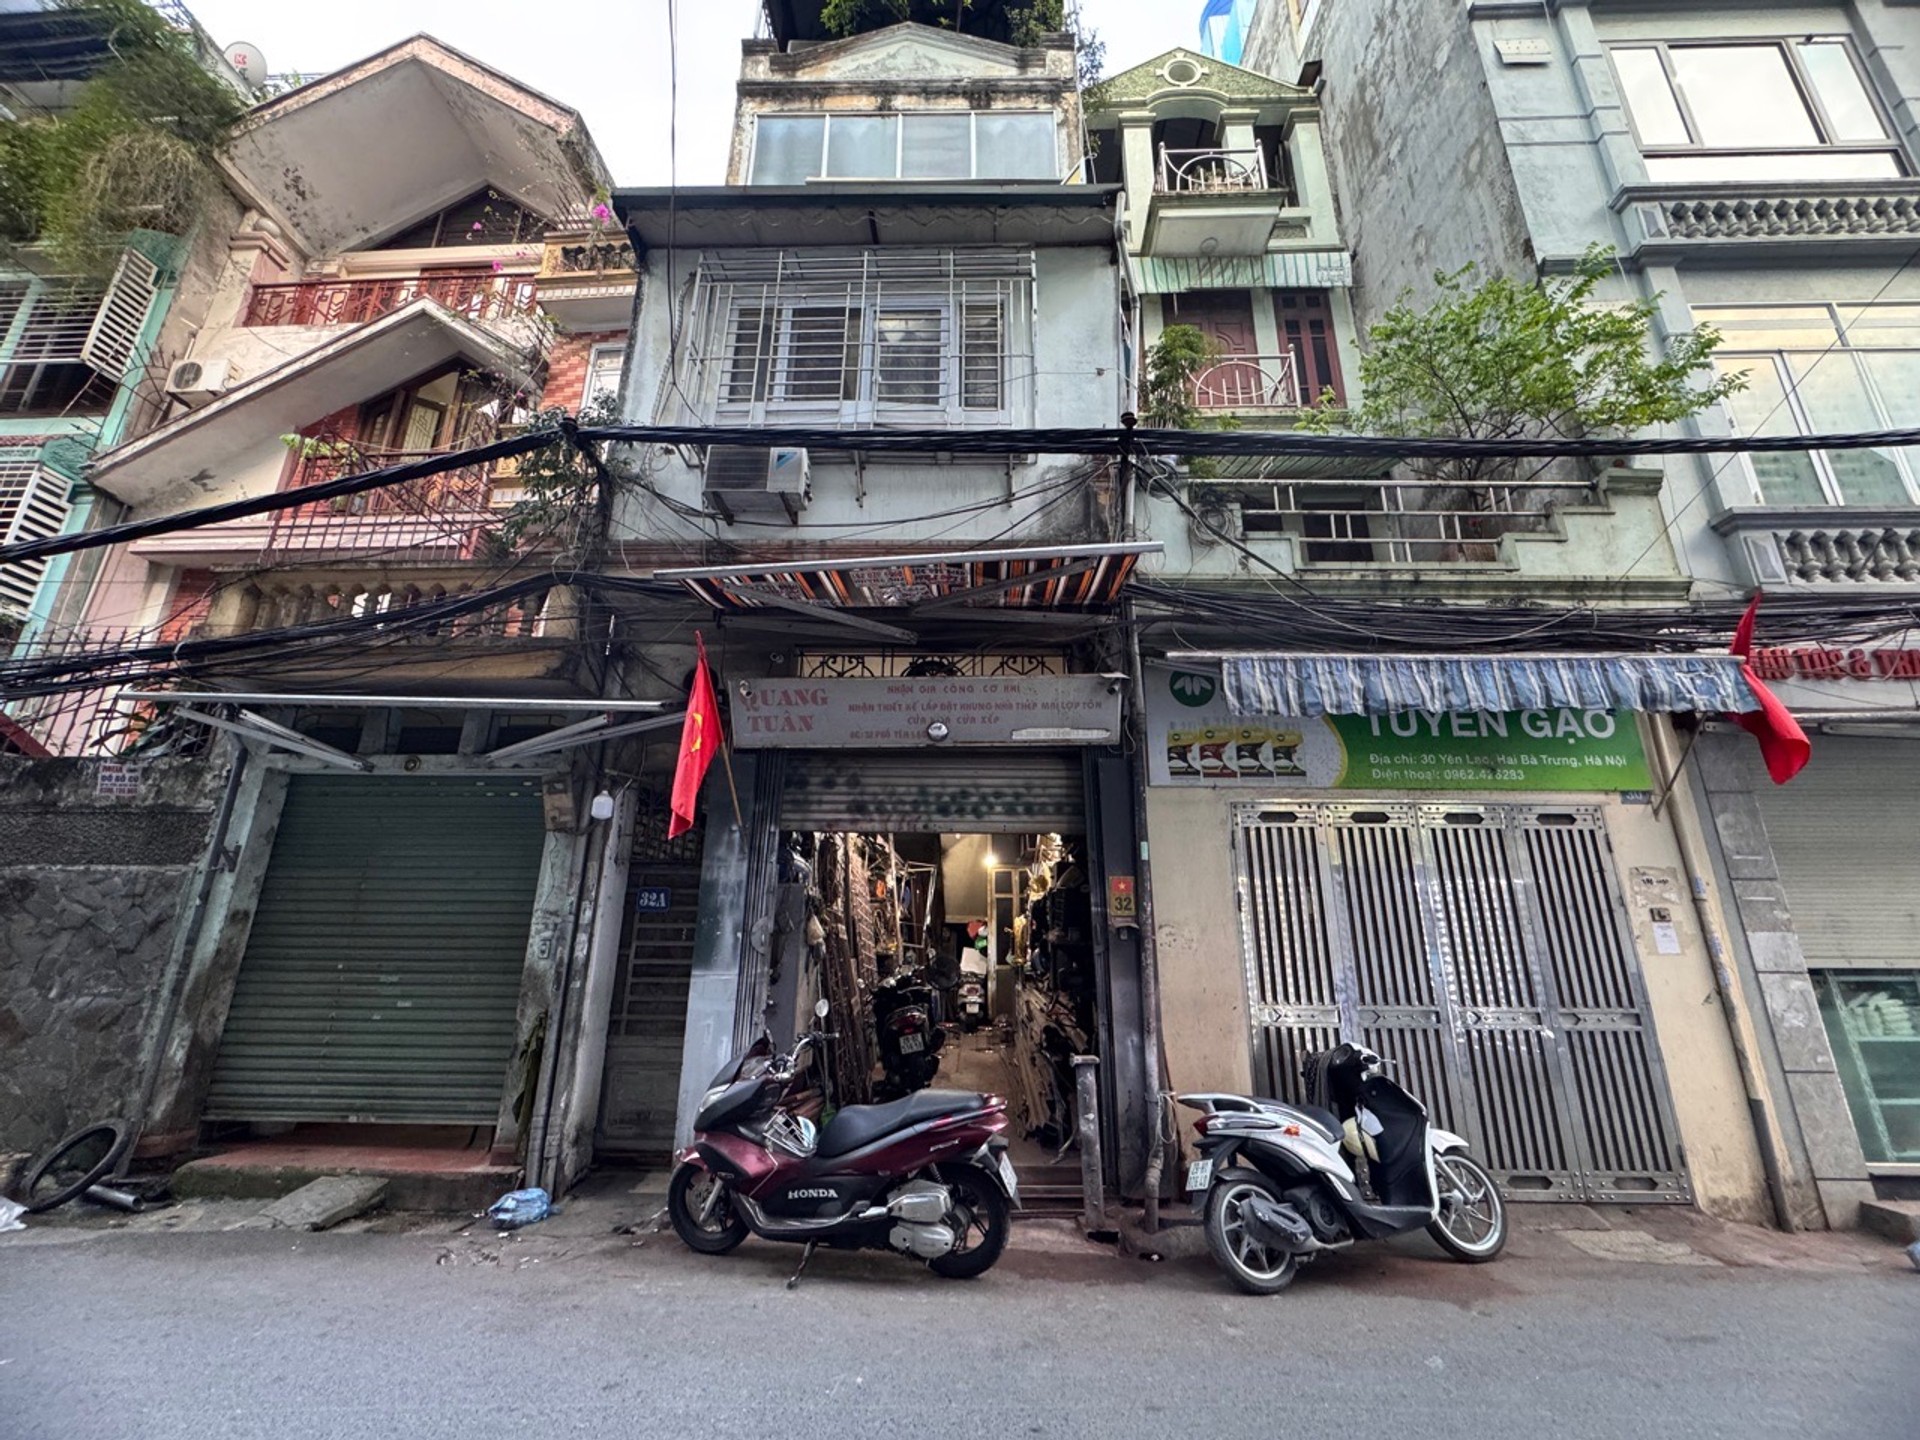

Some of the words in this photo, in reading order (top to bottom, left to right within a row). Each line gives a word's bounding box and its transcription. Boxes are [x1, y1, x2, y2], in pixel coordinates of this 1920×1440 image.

[1849, 648, 1872, 680] &
[943, 683, 975, 694] CÔNG
[747, 710, 815, 732] TUÂN
[1420, 754, 1436, 764] 30
[1496, 754, 1517, 765] Hai
[1520, 754, 1538, 765] Bà
[639, 891, 666, 907] 32A
[1114, 896, 1132, 912] 32
[787, 1187, 839, 1199] HONDA
